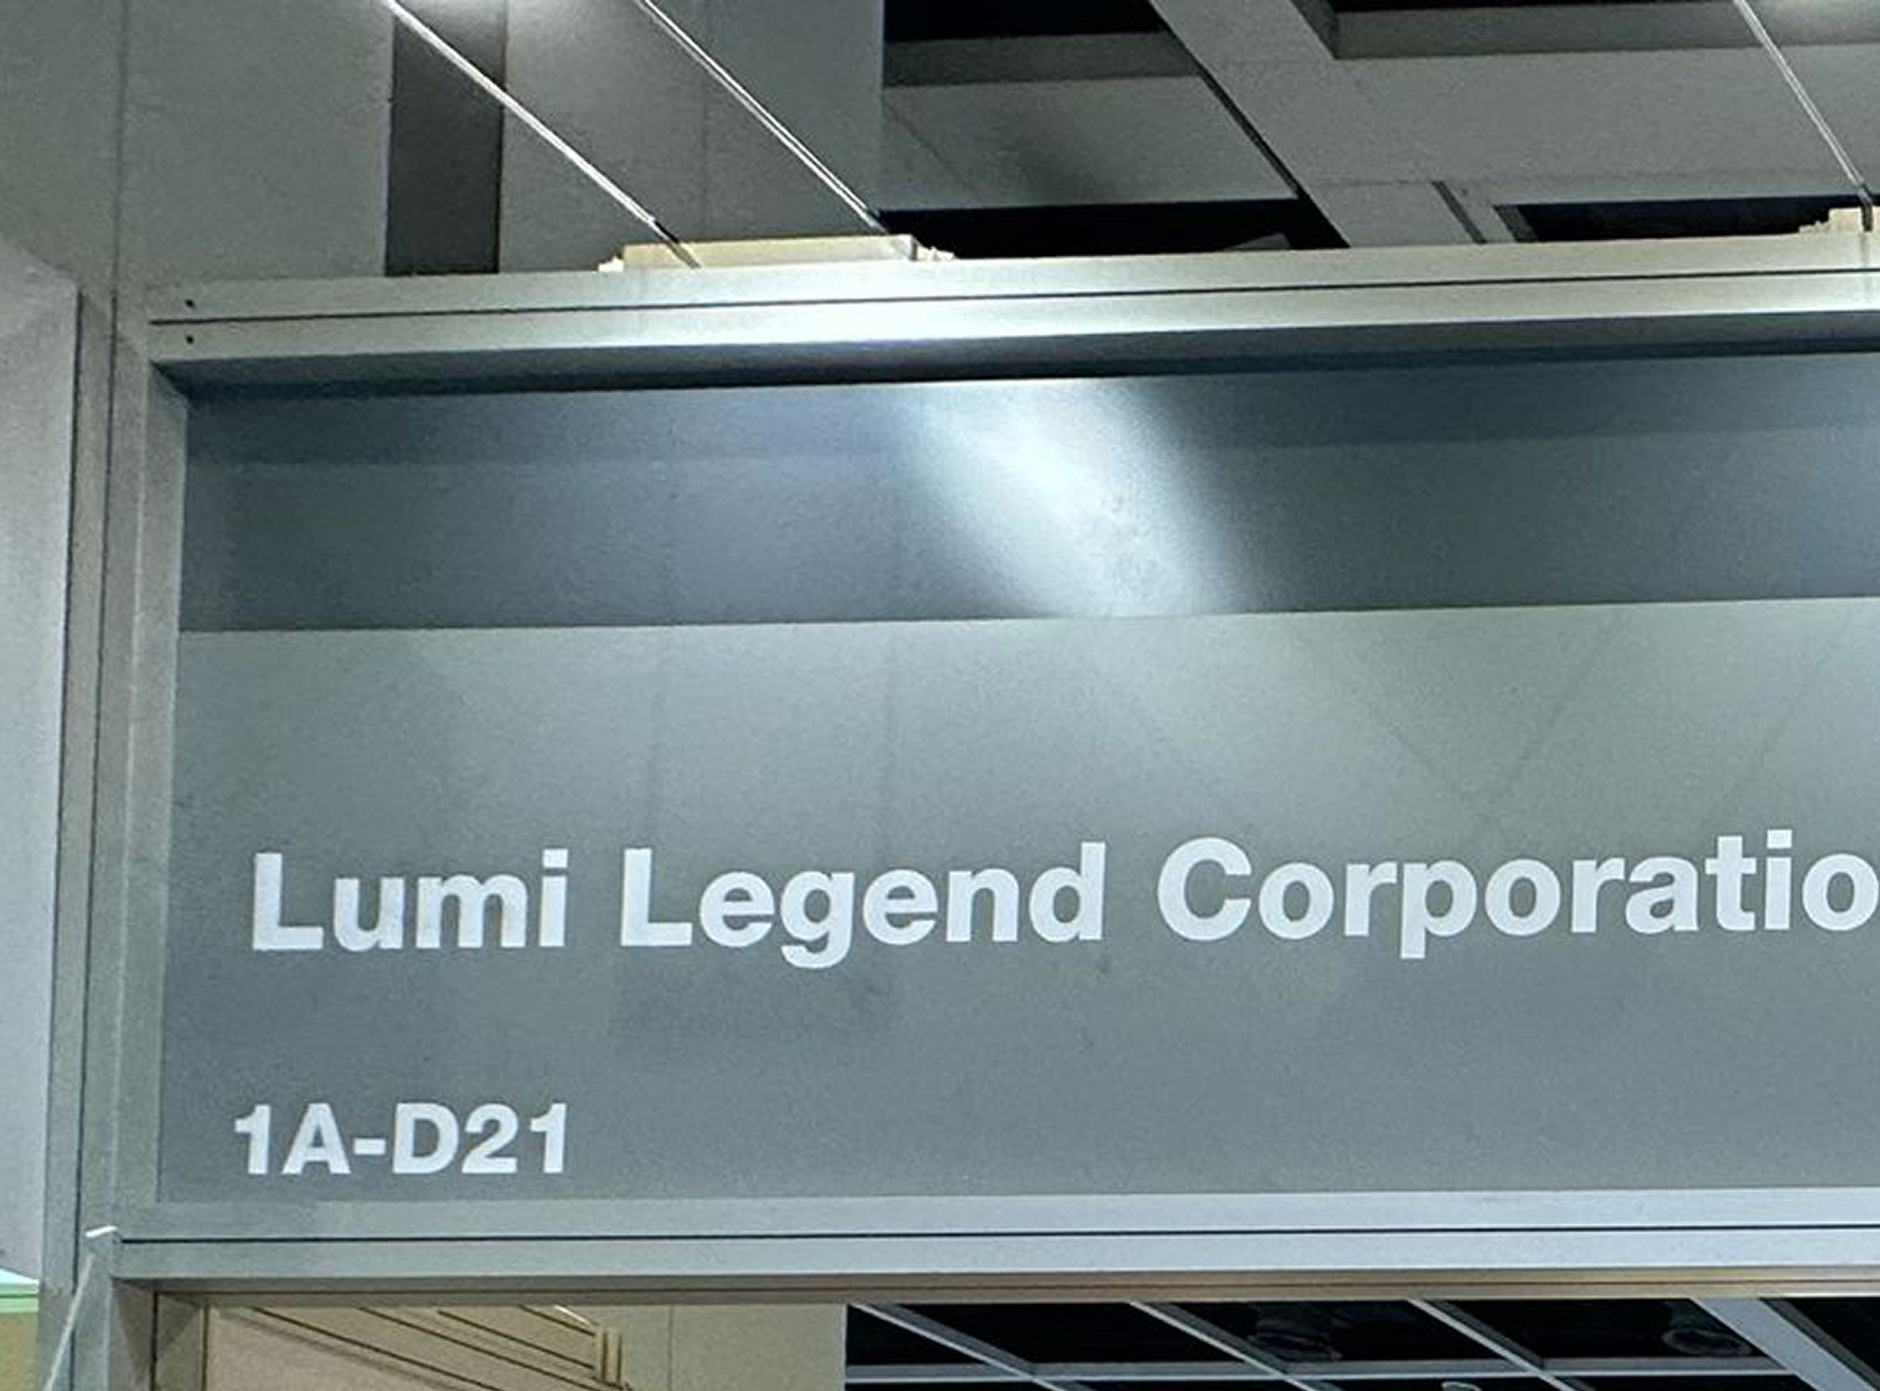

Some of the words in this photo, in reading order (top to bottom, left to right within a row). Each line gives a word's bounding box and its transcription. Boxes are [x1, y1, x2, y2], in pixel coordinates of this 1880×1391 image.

[252, 847, 570, 953] Lumi
[620, 840, 1107, 969] Legend
[233, 1101, 568, 1176] 1A-D21
